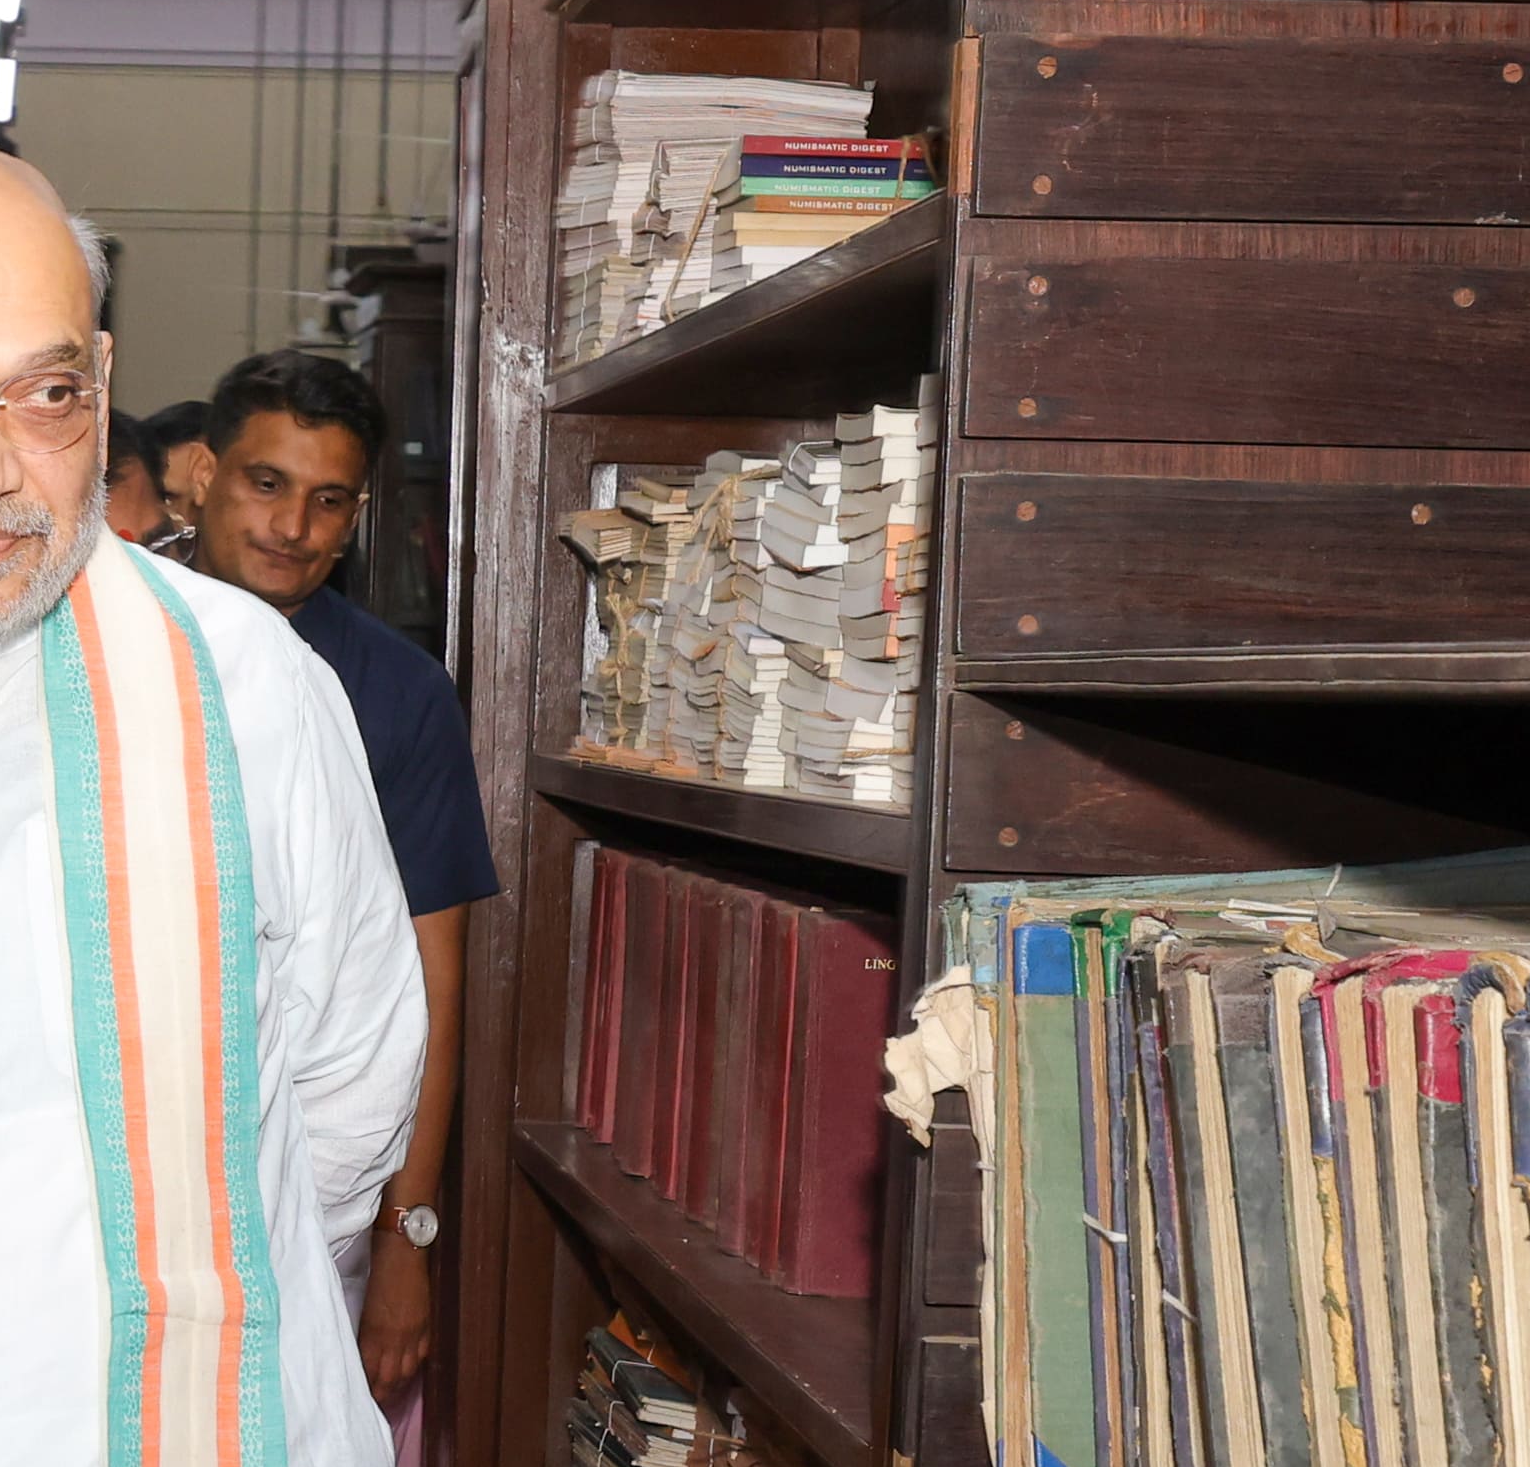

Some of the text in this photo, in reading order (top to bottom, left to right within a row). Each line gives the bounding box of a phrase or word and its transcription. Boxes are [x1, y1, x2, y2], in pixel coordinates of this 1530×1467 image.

[785, 141, 889, 153] NUMISMATIC DIGEST
[783, 165, 887, 175] NUMISMATIC DIGEST
[775, 184, 881, 195] NUMISMATIC DIGEST
[789, 200, 894, 212] NUMISMATIC DIGEST
[864, 957, 896, 971] LING
